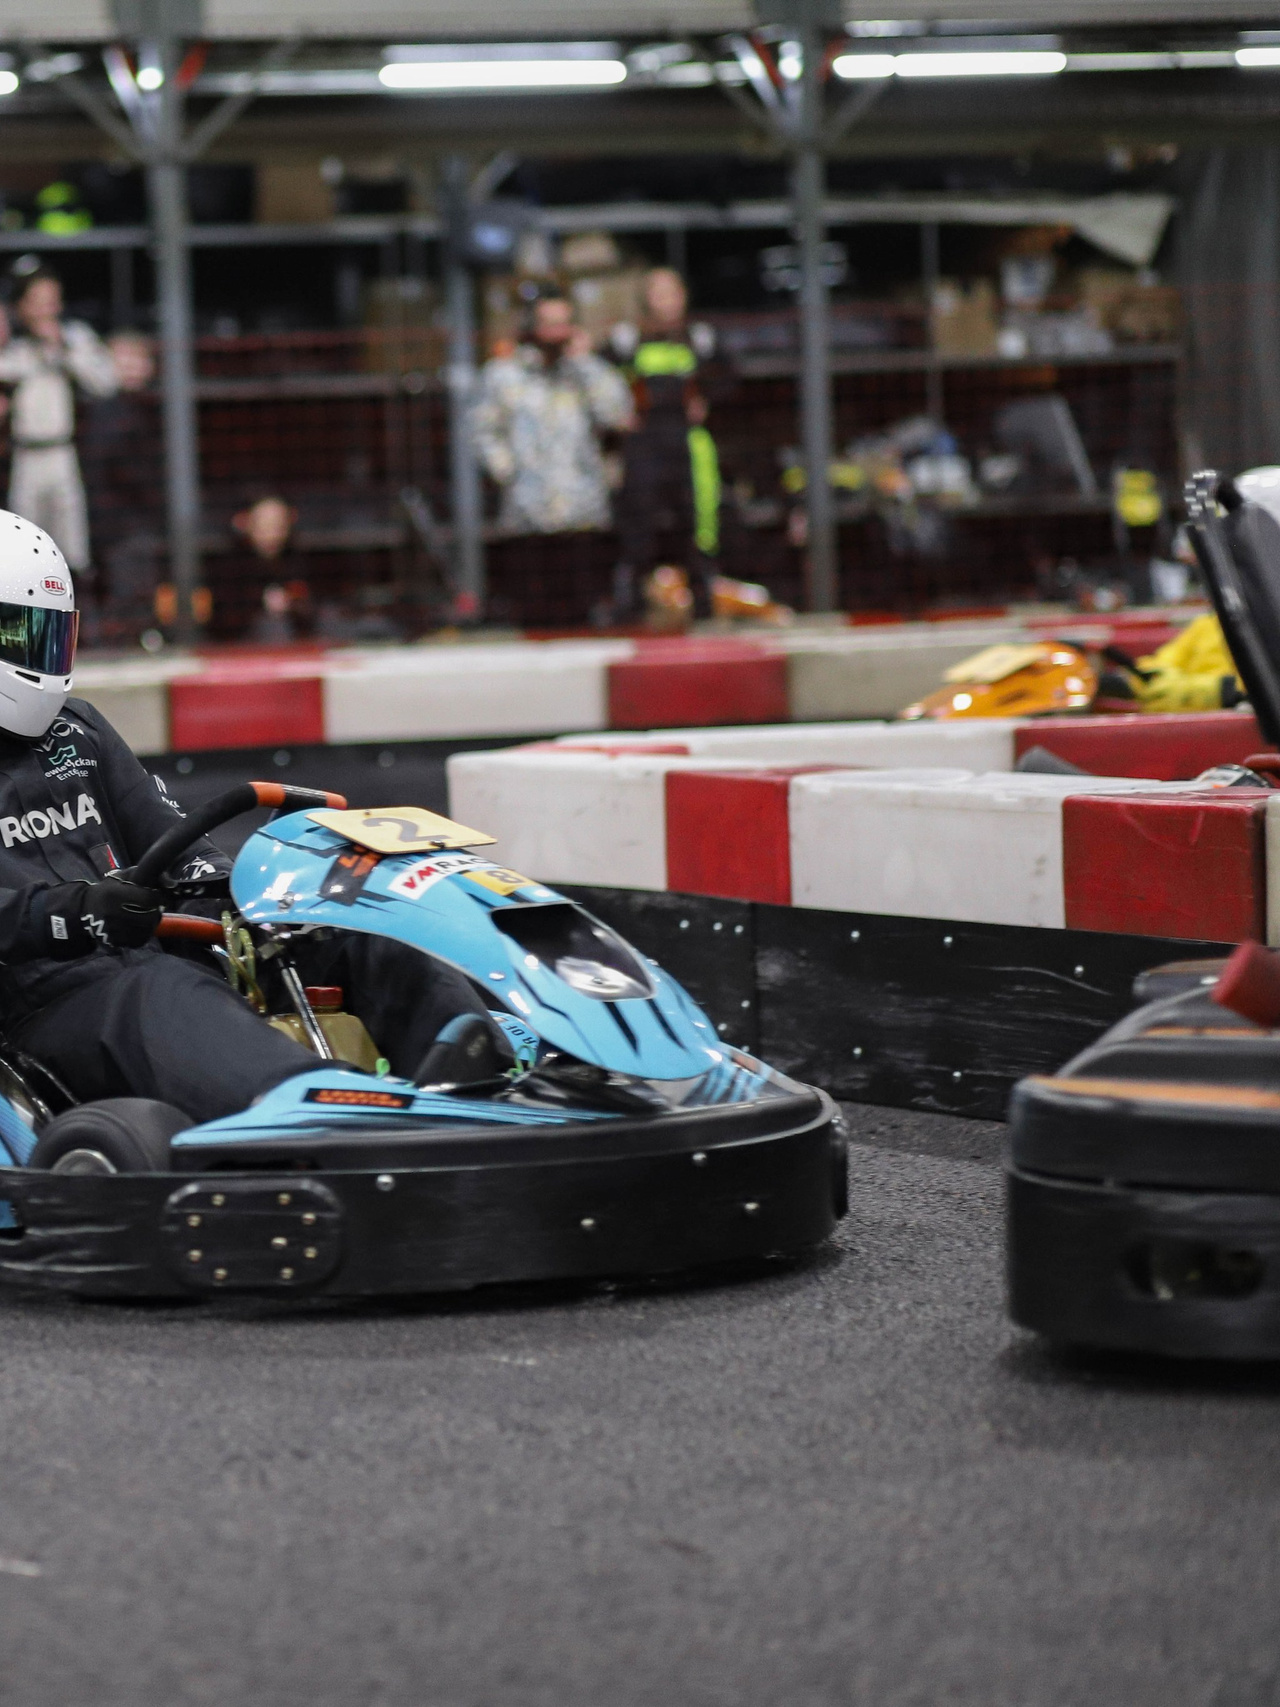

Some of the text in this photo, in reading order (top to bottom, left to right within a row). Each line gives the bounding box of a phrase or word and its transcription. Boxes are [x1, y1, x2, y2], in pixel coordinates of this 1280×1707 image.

[45, 580, 65, 591] BELL
[362, 817, 452, 843] 2
[485, 870, 526, 884] 8
